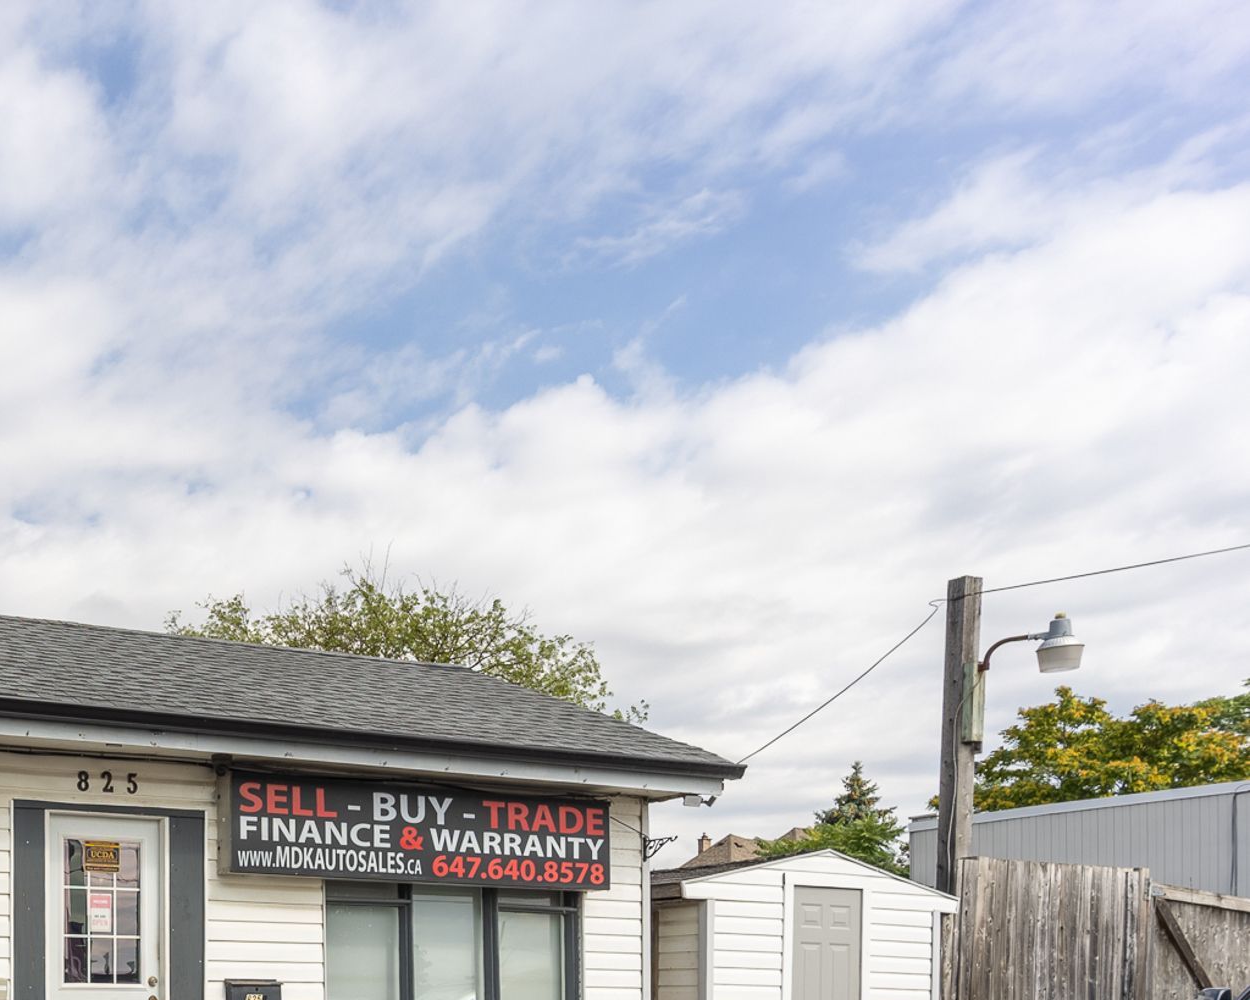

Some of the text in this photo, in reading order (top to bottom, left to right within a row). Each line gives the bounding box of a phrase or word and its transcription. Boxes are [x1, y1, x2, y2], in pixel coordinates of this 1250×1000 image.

[77, 771, 138, 794] 825
[239, 782, 338, 817] SELL
[373, 792, 453, 825] BUY
[483, 800, 605, 836] TRADE
[239, 815, 605, 861] FINANCE & WARRANTY
[432, 855, 605, 885] 647.640.8578
